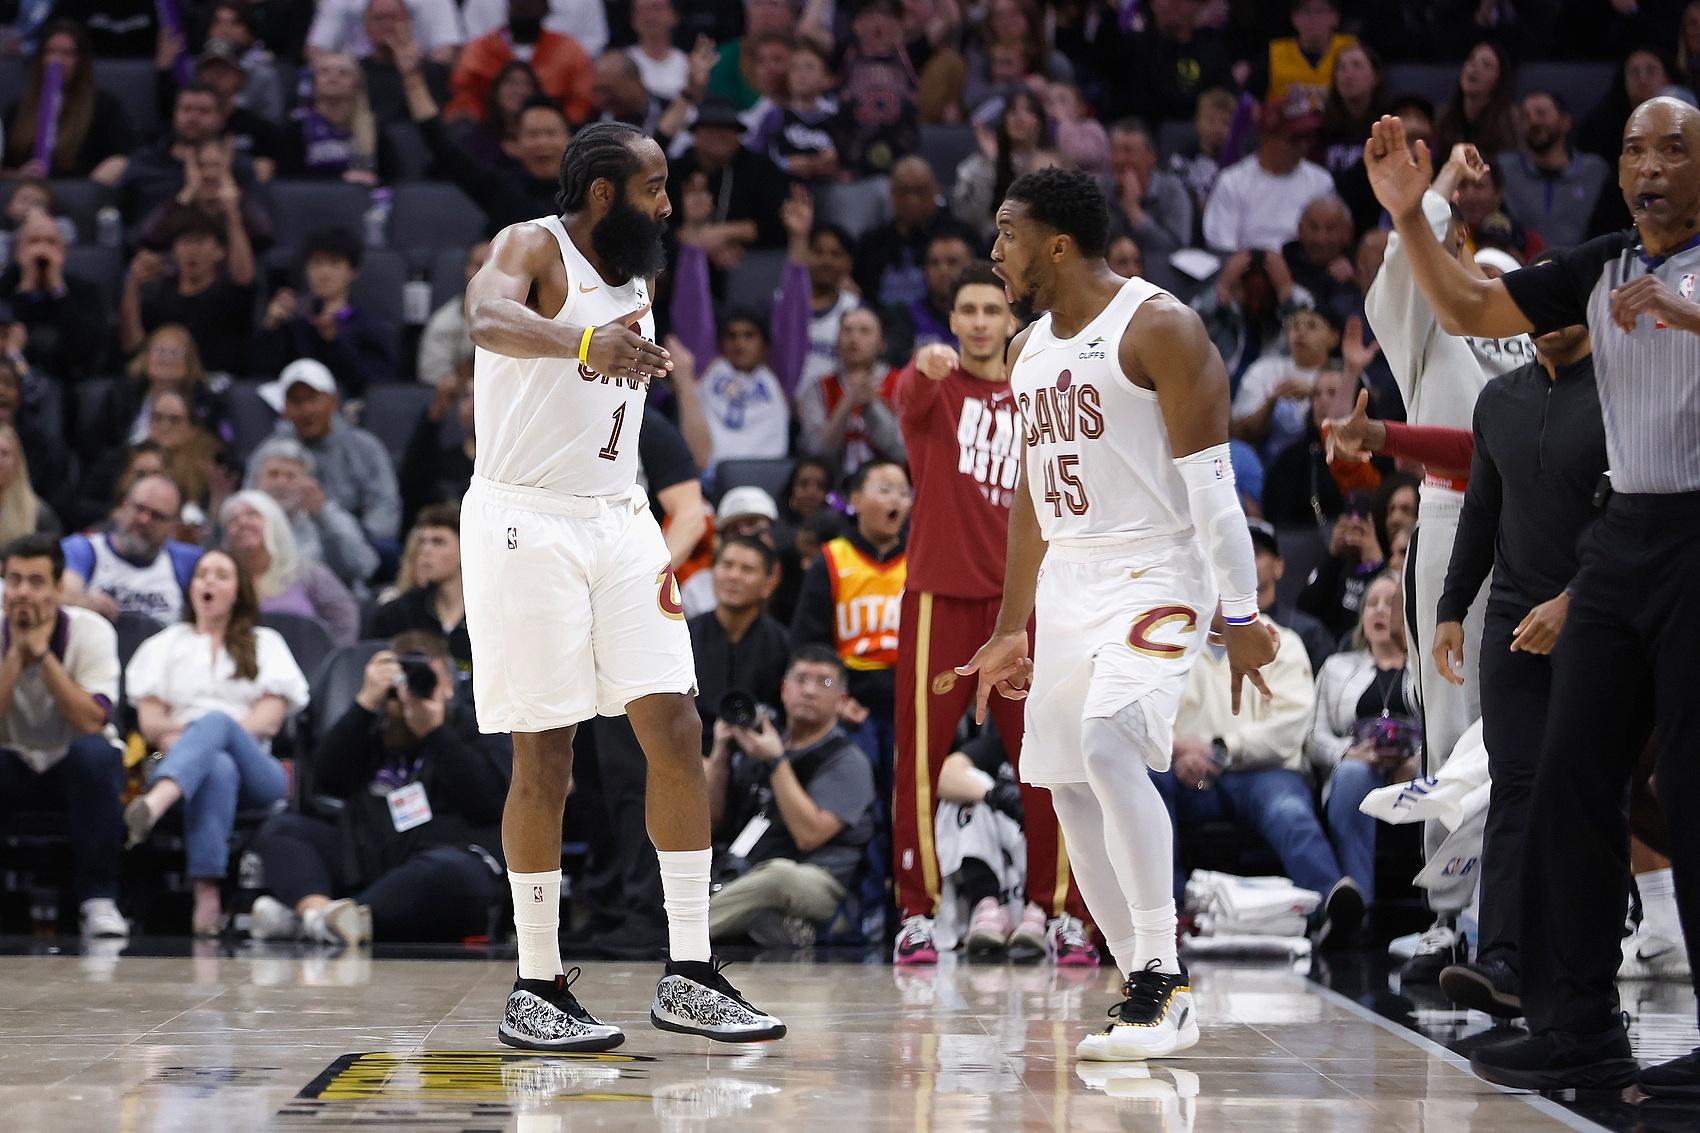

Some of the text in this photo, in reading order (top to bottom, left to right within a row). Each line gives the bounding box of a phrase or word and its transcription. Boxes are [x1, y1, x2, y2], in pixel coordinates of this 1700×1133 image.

[1079, 352, 1105, 360] CLIFFS
[598, 400, 627, 461] 1
[1019, 383, 1104, 447] CAVS
[1043, 454, 1089, 518] 45
[836, 595, 902, 641] UTA
